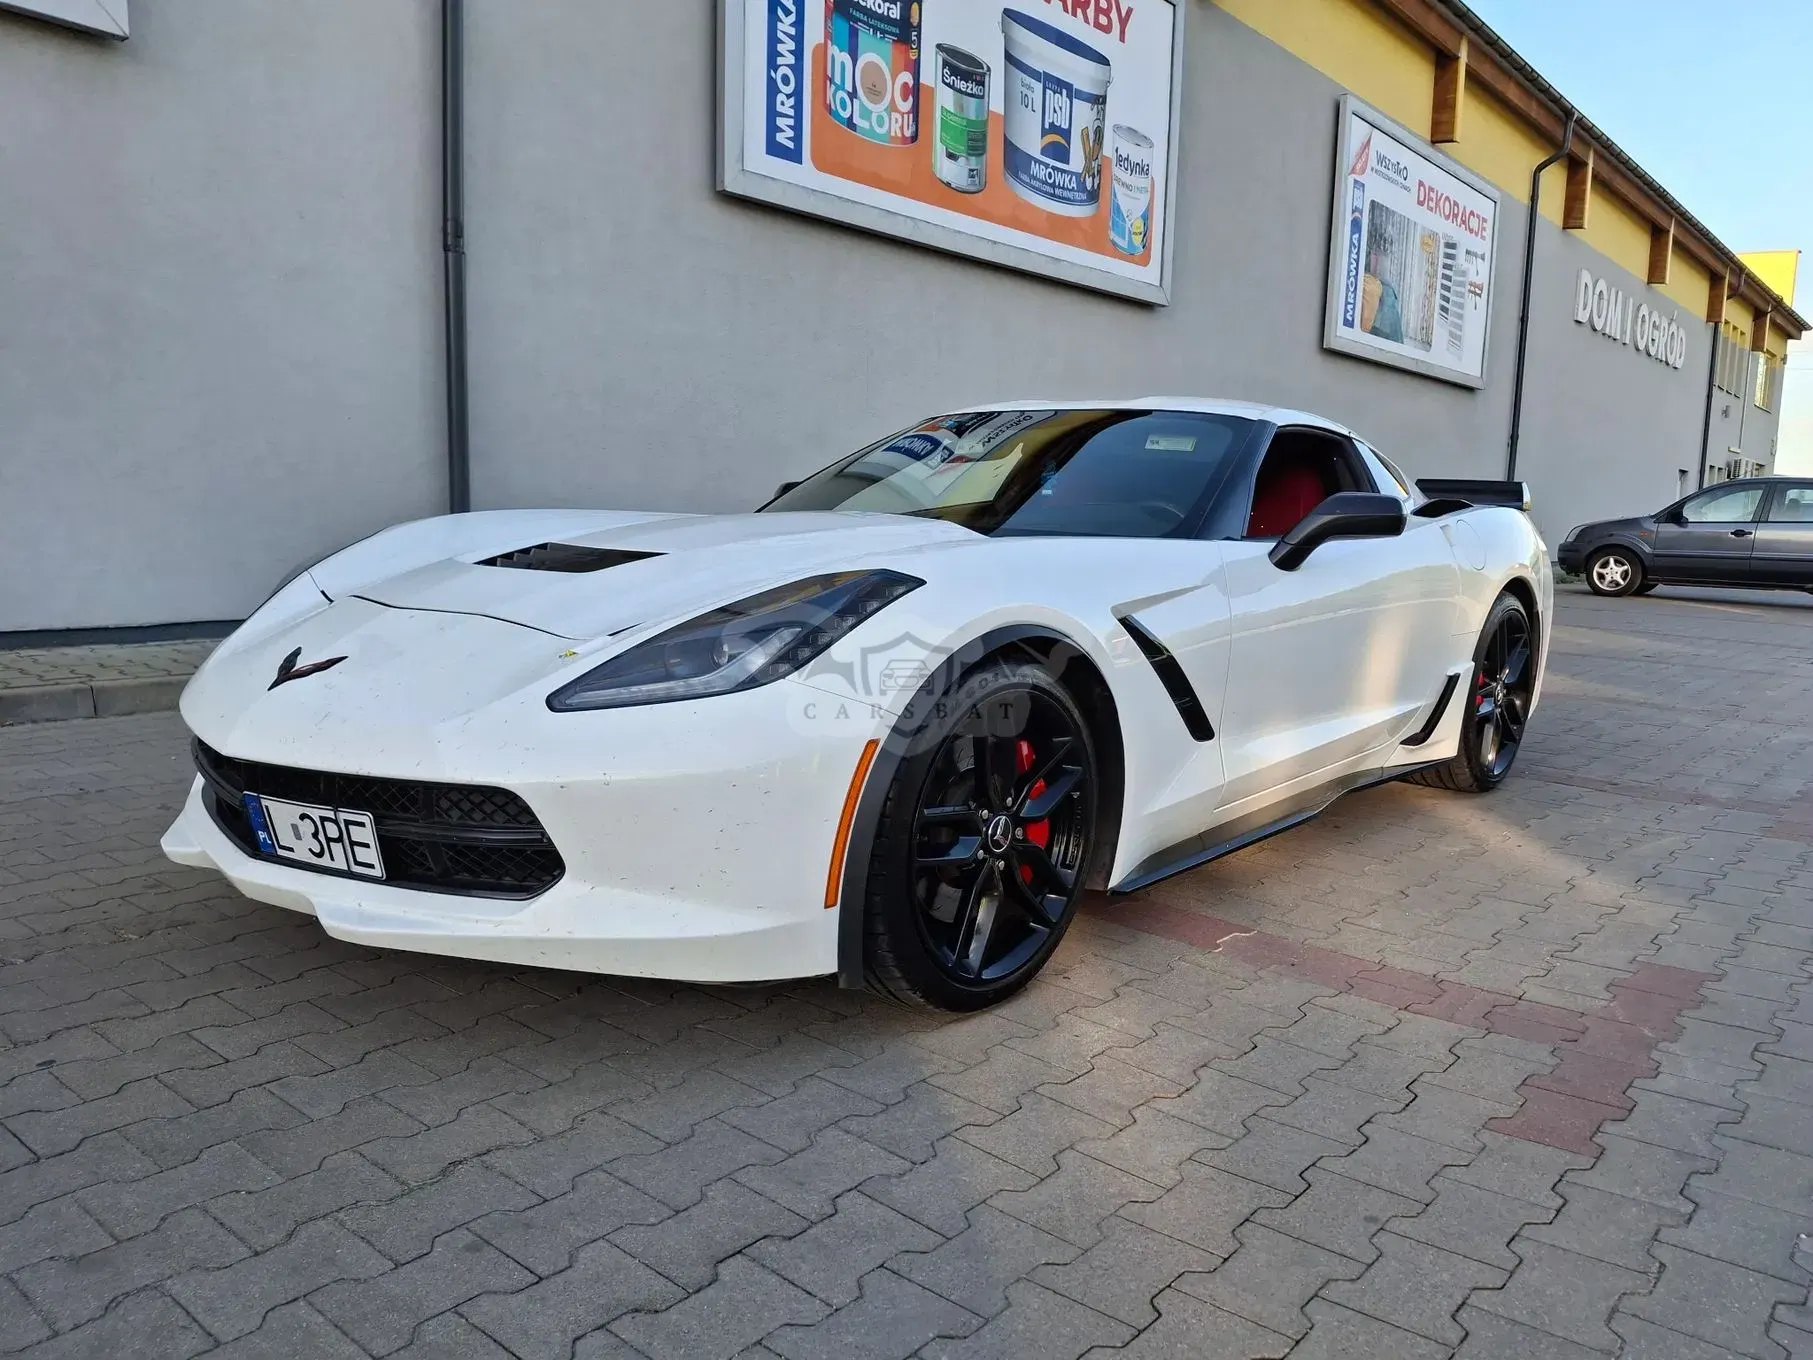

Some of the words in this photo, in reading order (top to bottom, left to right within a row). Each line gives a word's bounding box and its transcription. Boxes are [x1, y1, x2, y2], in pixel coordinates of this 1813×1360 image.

[849, 7, 868, 22] FARBA
[868, 17, 900, 34] LATEKSOWA
[911, 31, 918, 49] 5
[943, 66, 984, 97] Śnieżka
[1020, 90, 1029, 109] 10
[1031, 98, 1036, 113] L
[1044, 87, 1070, 130] psb
[1030, 160, 1078, 190] MRÓWKA
[1416, 178, 1488, 242] DEKORACJE
[1346, 233, 1359, 321] MRÓWKA
[1574, 268, 1623, 341] DOM
[1622, 296, 1633, 345] I
[1634, 303, 1686, 370] OGRÓD
[257, 830, 272, 844] PL
